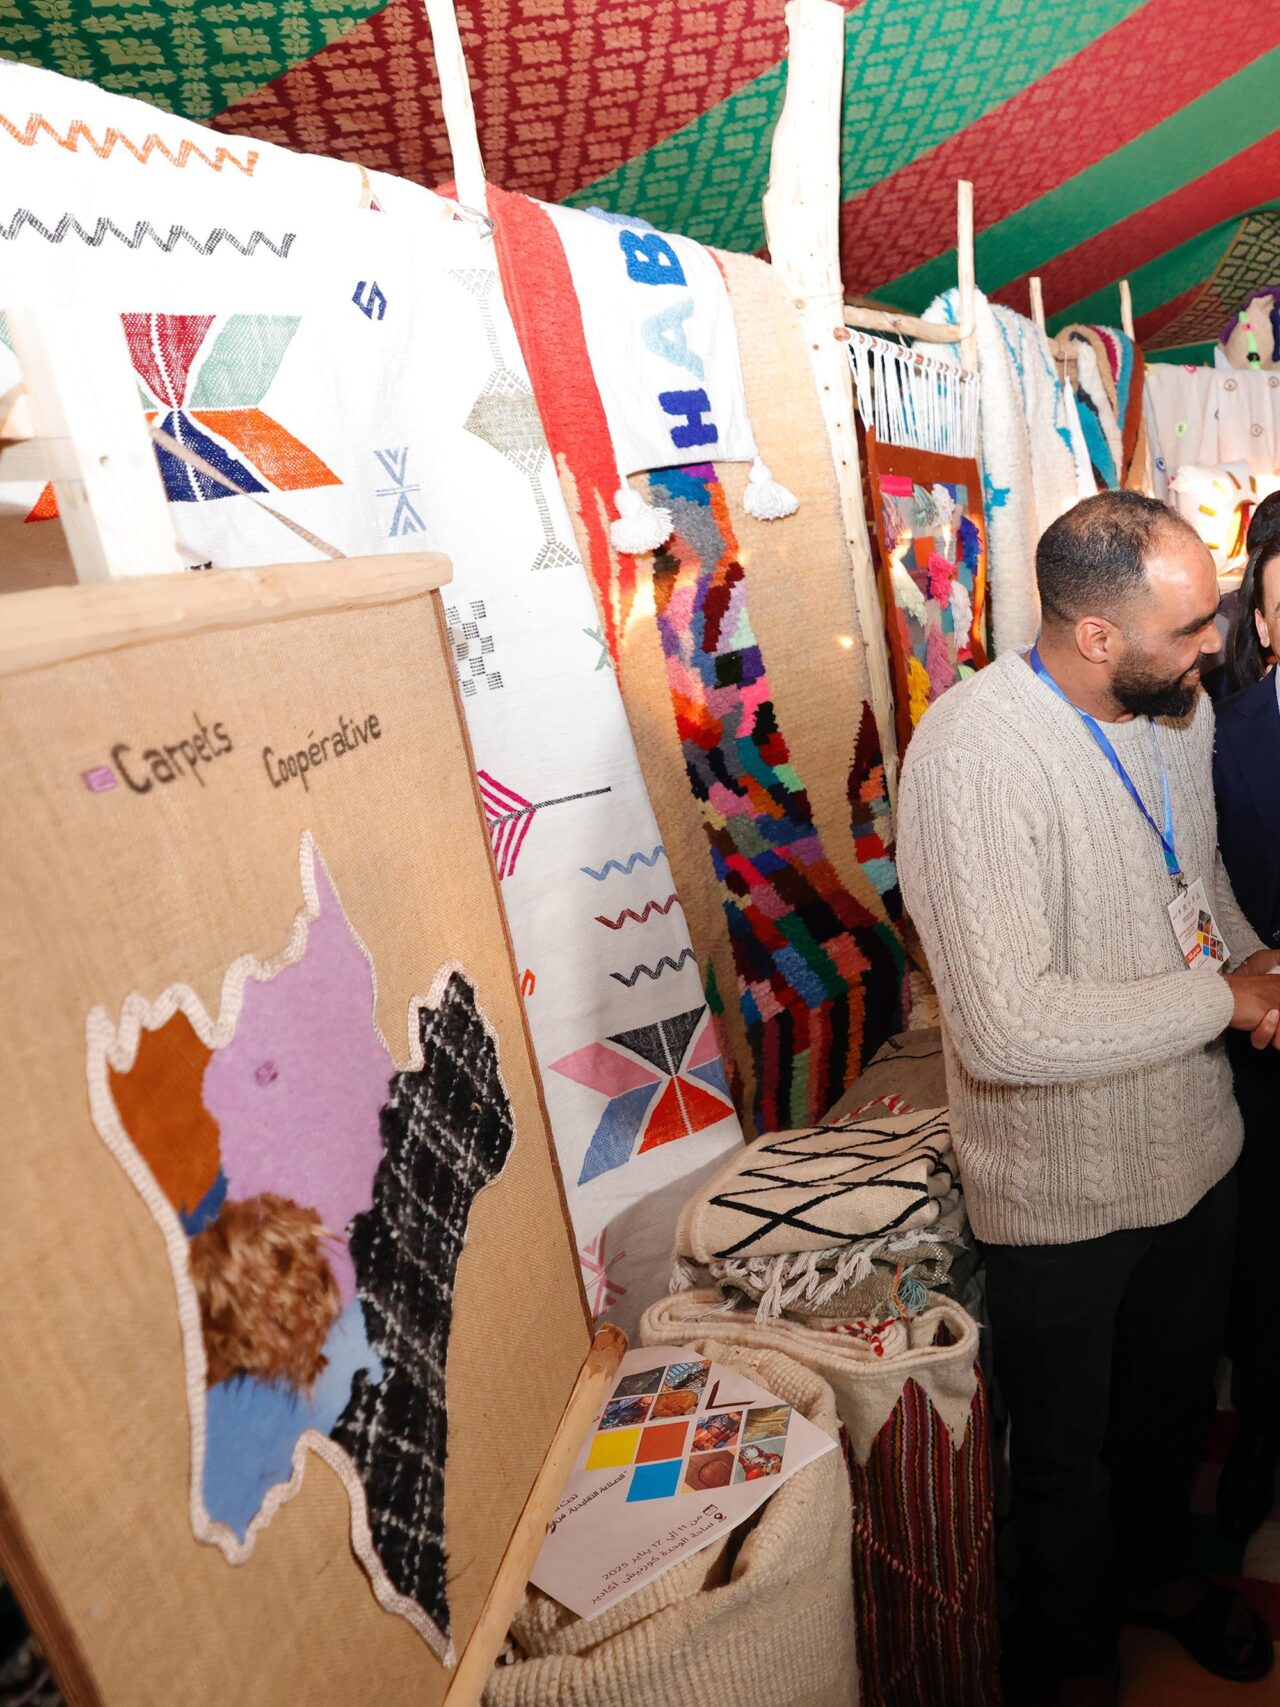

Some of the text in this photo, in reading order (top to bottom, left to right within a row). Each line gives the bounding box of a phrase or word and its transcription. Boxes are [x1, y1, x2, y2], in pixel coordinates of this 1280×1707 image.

[110, 711, 382, 794] Carpets Coopérative
[690, 1515, 703, 1526] من
[689, 1522, 714, 1538] ساحة
[651, 1539, 661, 1548] 17
[660, 1537, 689, 1557] الوحدة
[631, 1548, 653, 1564] يناير
[602, 1561, 629, 1580] 2025
[622, 1555, 660, 1584] كورنيش
